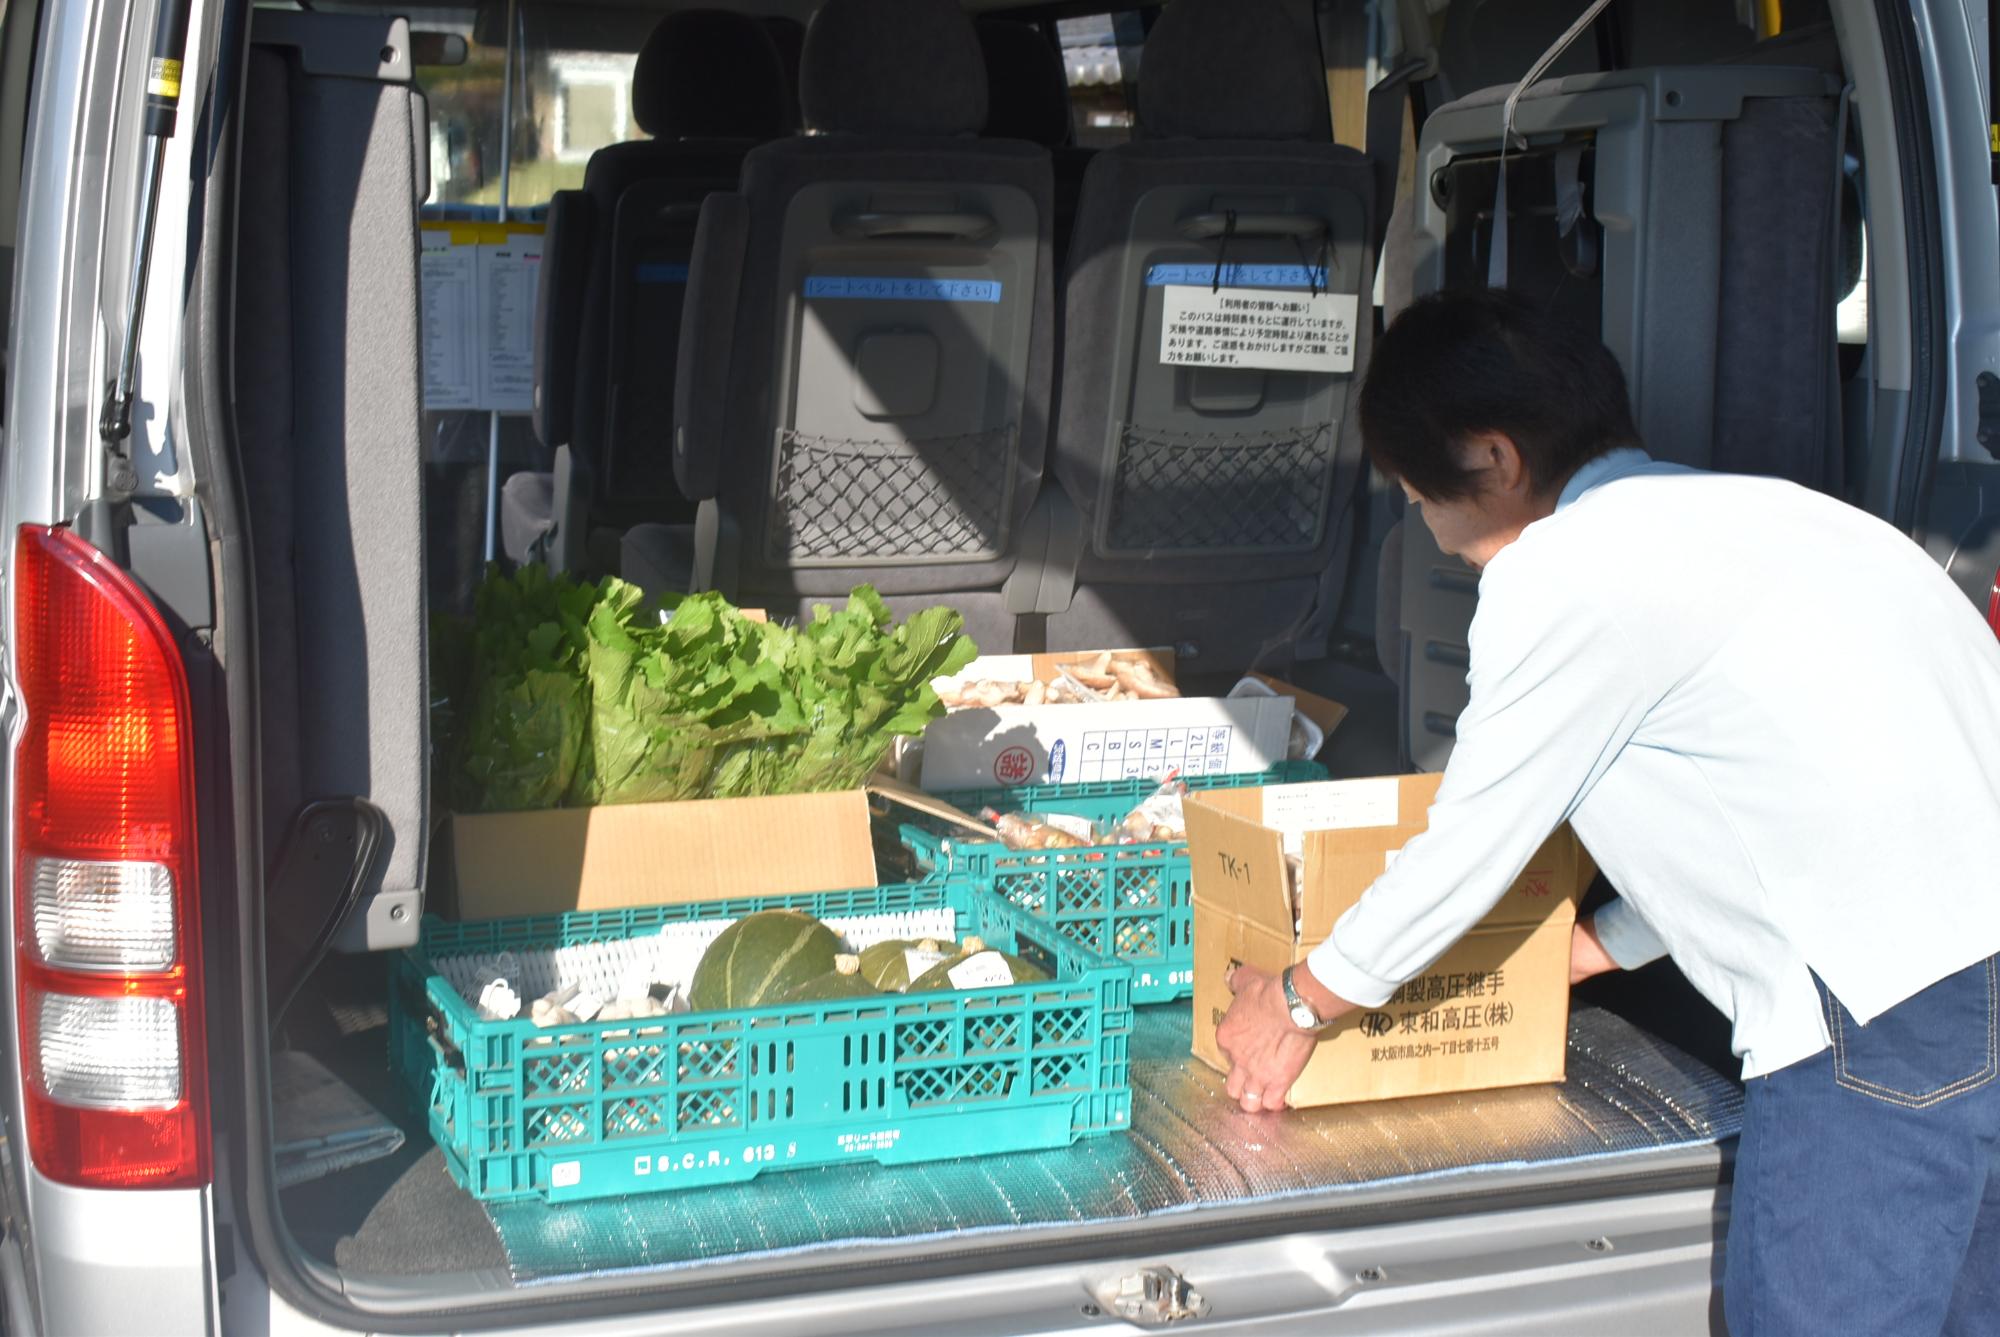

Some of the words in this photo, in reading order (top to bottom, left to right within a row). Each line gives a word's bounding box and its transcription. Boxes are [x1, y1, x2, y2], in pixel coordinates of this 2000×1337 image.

[1129, 741, 1142, 749] S
[1149, 738, 1163, 749] M
[1190, 735, 1203, 750] 2L
[1218, 851, 1251, 885] TK-1
